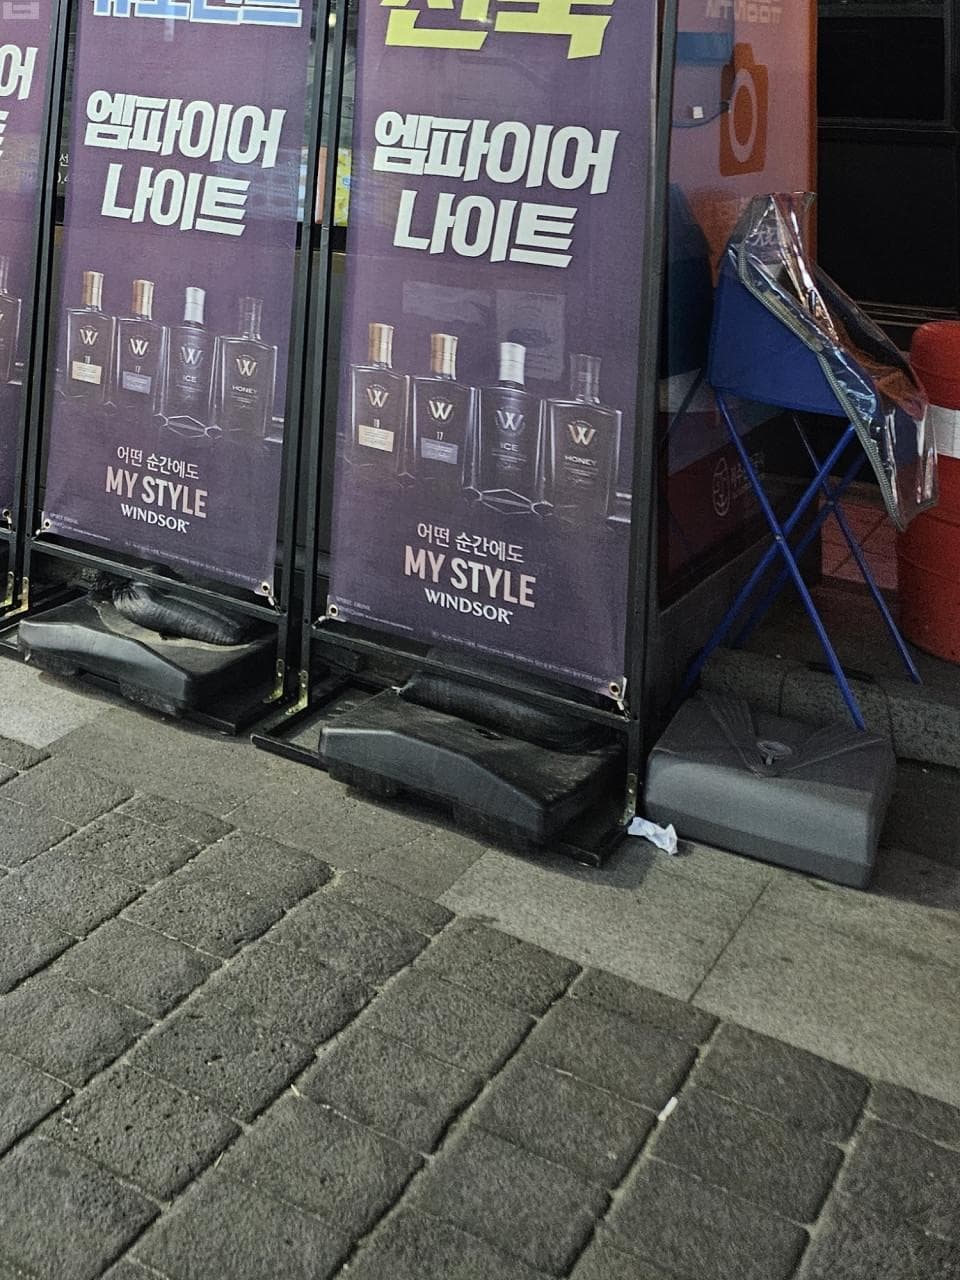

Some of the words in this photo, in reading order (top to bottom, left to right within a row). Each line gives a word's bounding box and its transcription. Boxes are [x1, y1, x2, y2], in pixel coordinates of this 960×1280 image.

[83, 89, 287, 169] 엠파이어
[372, 111, 620, 195] 엠파이어
[100, 162, 252, 237] 나이트
[393, 189, 578, 269] 나이트
[116, 446, 144, 468] 어떤
[145, 452, 201, 480] 순간에도
[499, 442, 520, 453] ICE
[564, 454, 599, 467] HONEY
[104, 465, 140, 499] MY
[141, 476, 209, 519] STYLE
[120, 503, 191, 535] WINDSOR
[417, 522, 451, 549] 어떤
[455, 531, 526, 563] 순간에도
[404, 544, 446, 584] MY
[450, 556, 537, 609] STYLE
[424, 587, 514, 625] WINDSOR
